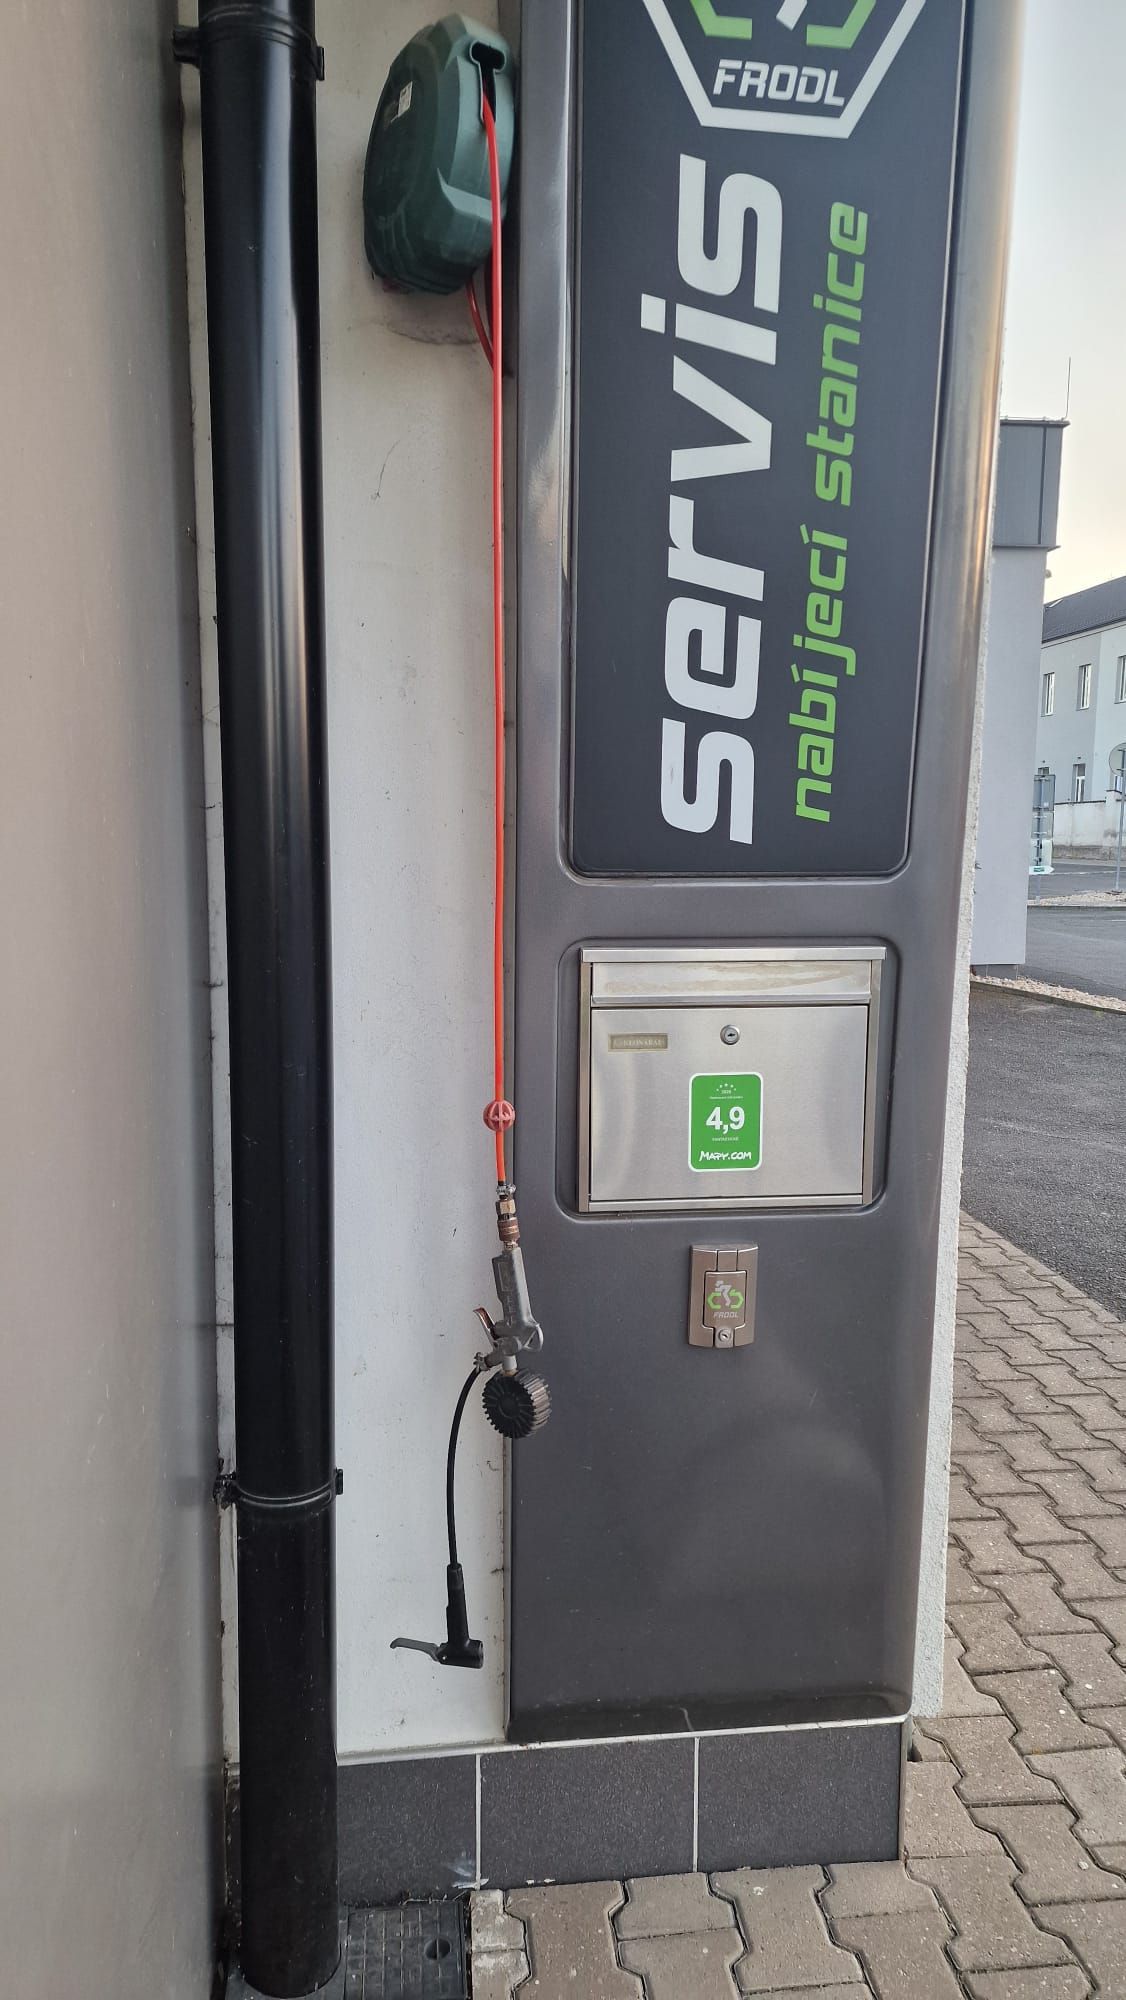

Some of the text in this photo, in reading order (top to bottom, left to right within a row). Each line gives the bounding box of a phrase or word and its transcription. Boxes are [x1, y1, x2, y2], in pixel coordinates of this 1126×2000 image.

[713, 59, 845, 107] FRODL
[640, 153, 783, 845] servis
[789, 201, 868, 823] nabíjecí stanice
[705, 1106, 745, 1135] 4,9
